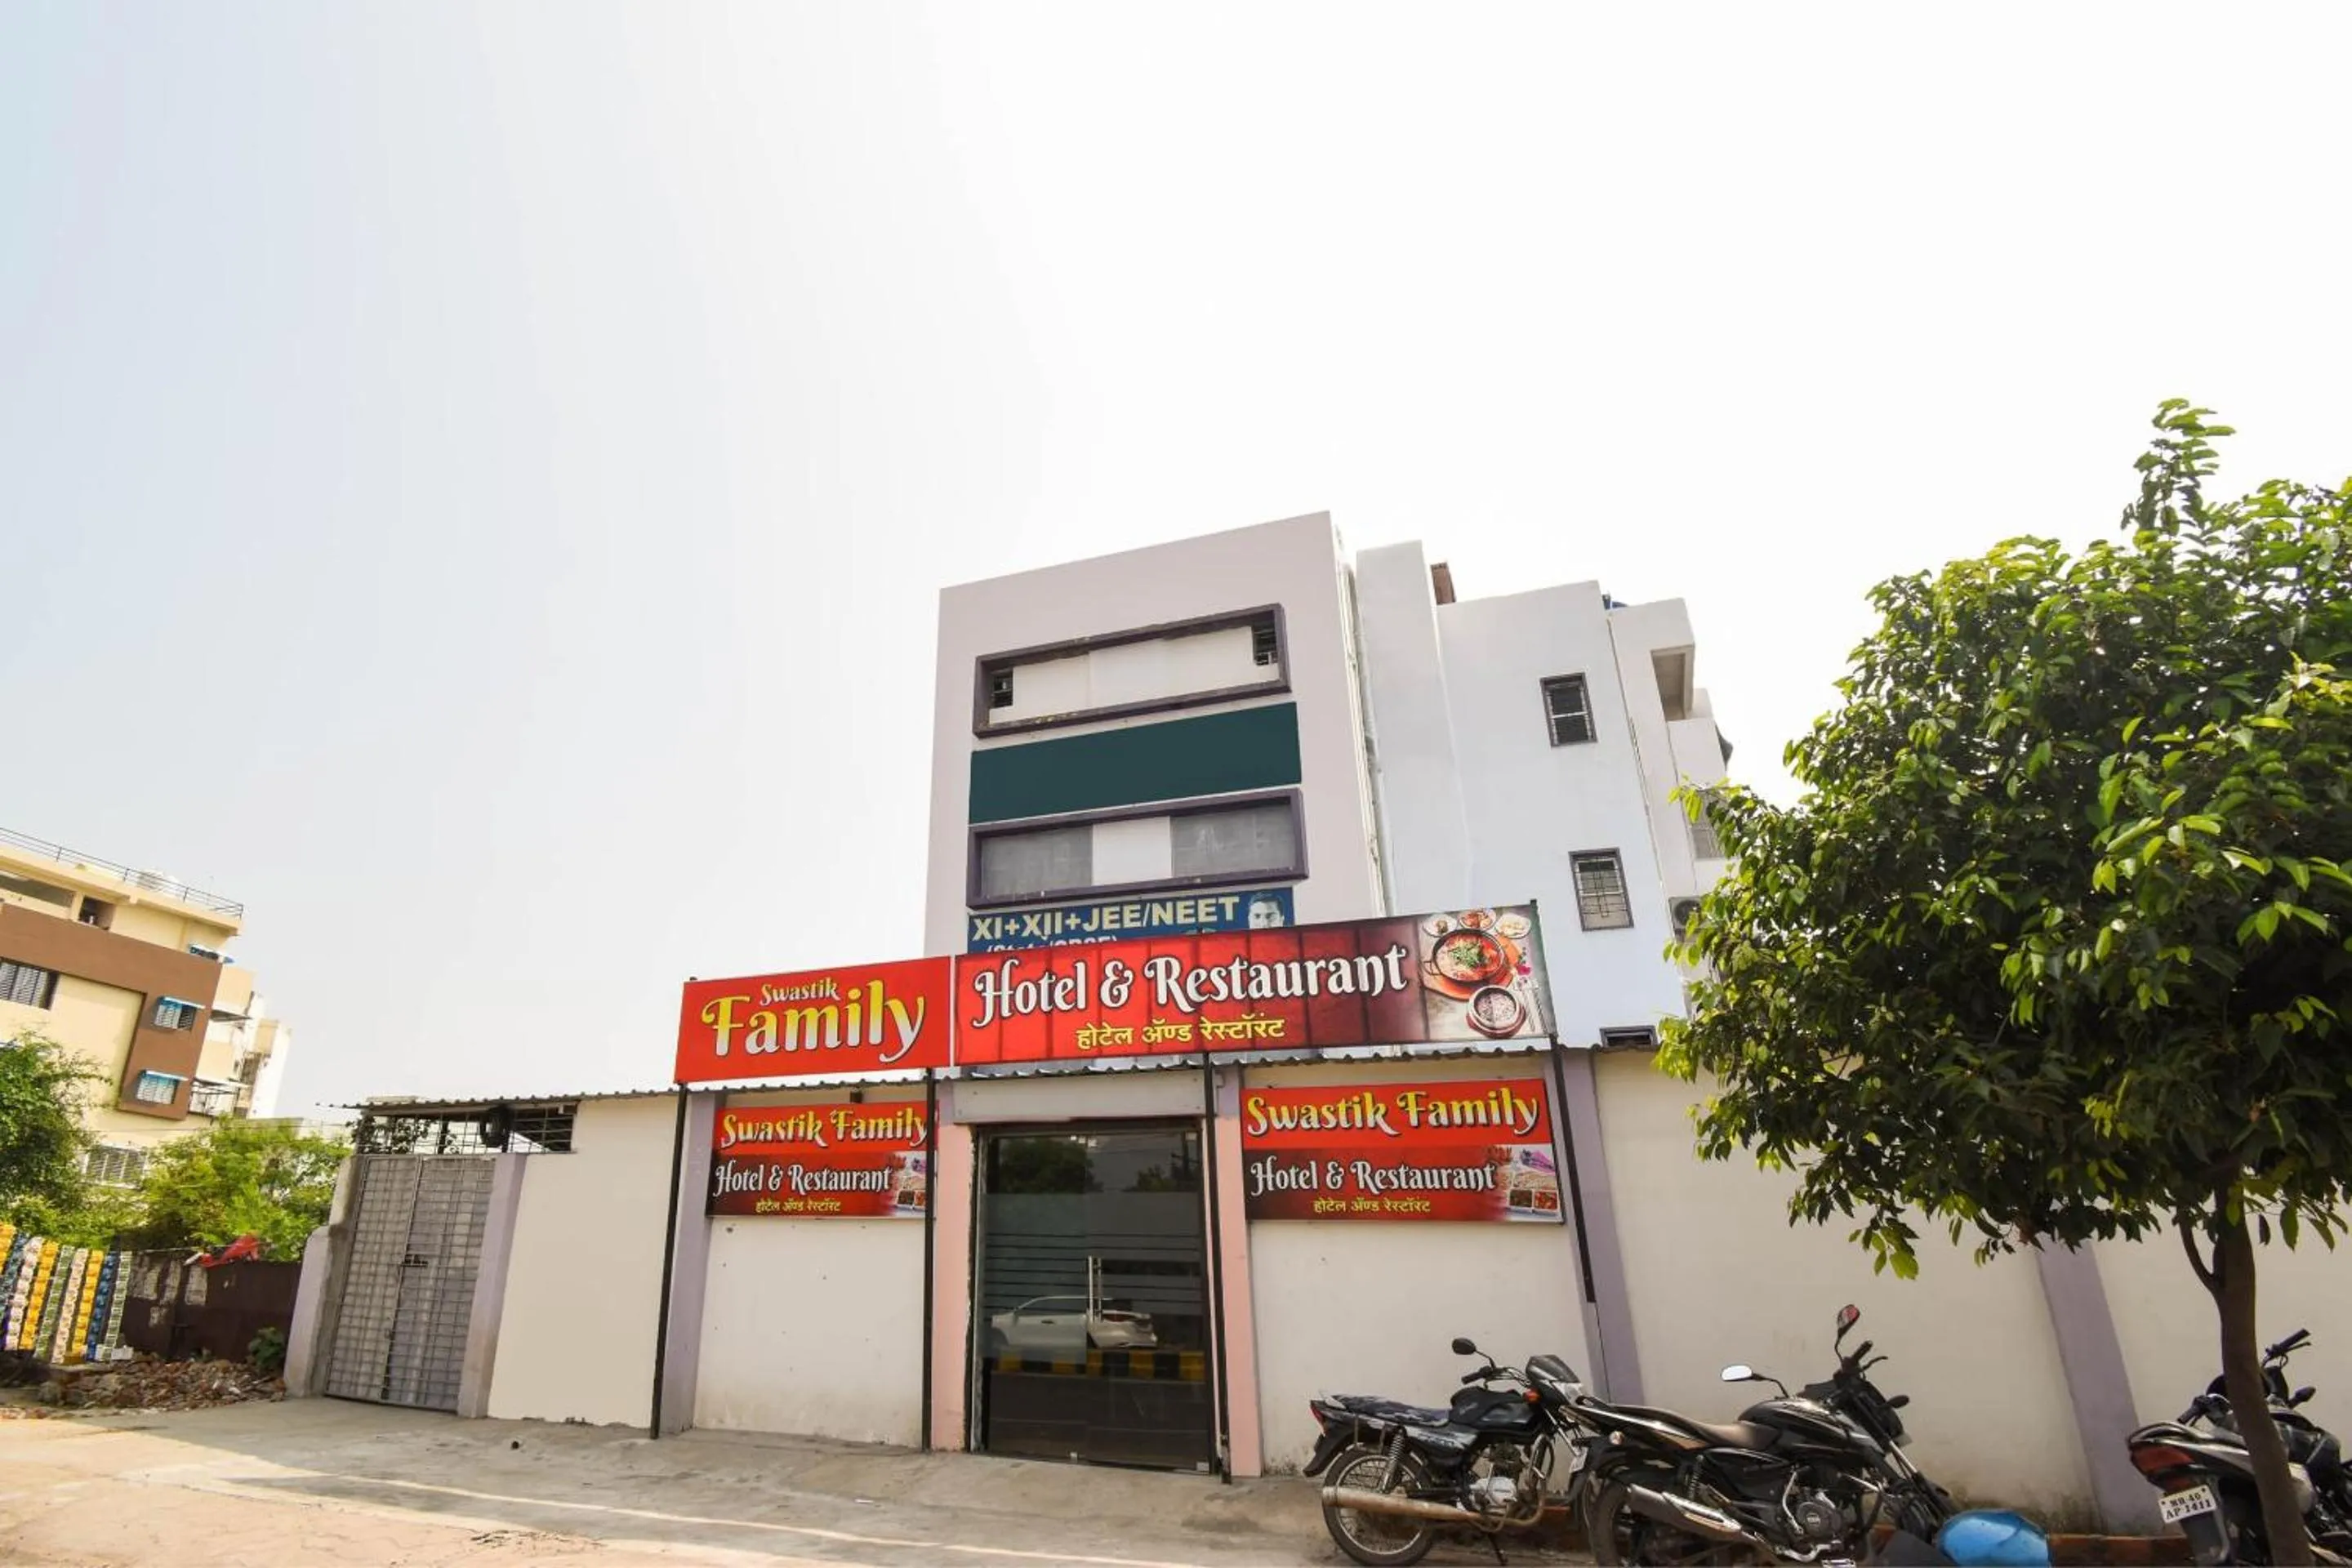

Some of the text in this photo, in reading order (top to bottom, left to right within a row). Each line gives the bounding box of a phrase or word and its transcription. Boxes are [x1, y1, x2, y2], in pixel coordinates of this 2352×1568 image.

[760, 977, 840, 1006] Swastik
[972, 943, 1409, 1027] Hotel & Restaurant
[702, 979, 925, 1062] Family
[1076, 1022, 1134, 1049] होटेल
[721, 1107, 928, 1148] Swastik Family
[1247, 1087, 1539, 1137] Swastik Family
[713, 1160, 893, 1196] Hotel & Restaurant
[1250, 1155, 1496, 1196] Hotel & Restaurant
[1313, 1196, 1347, 1214] होटेल
